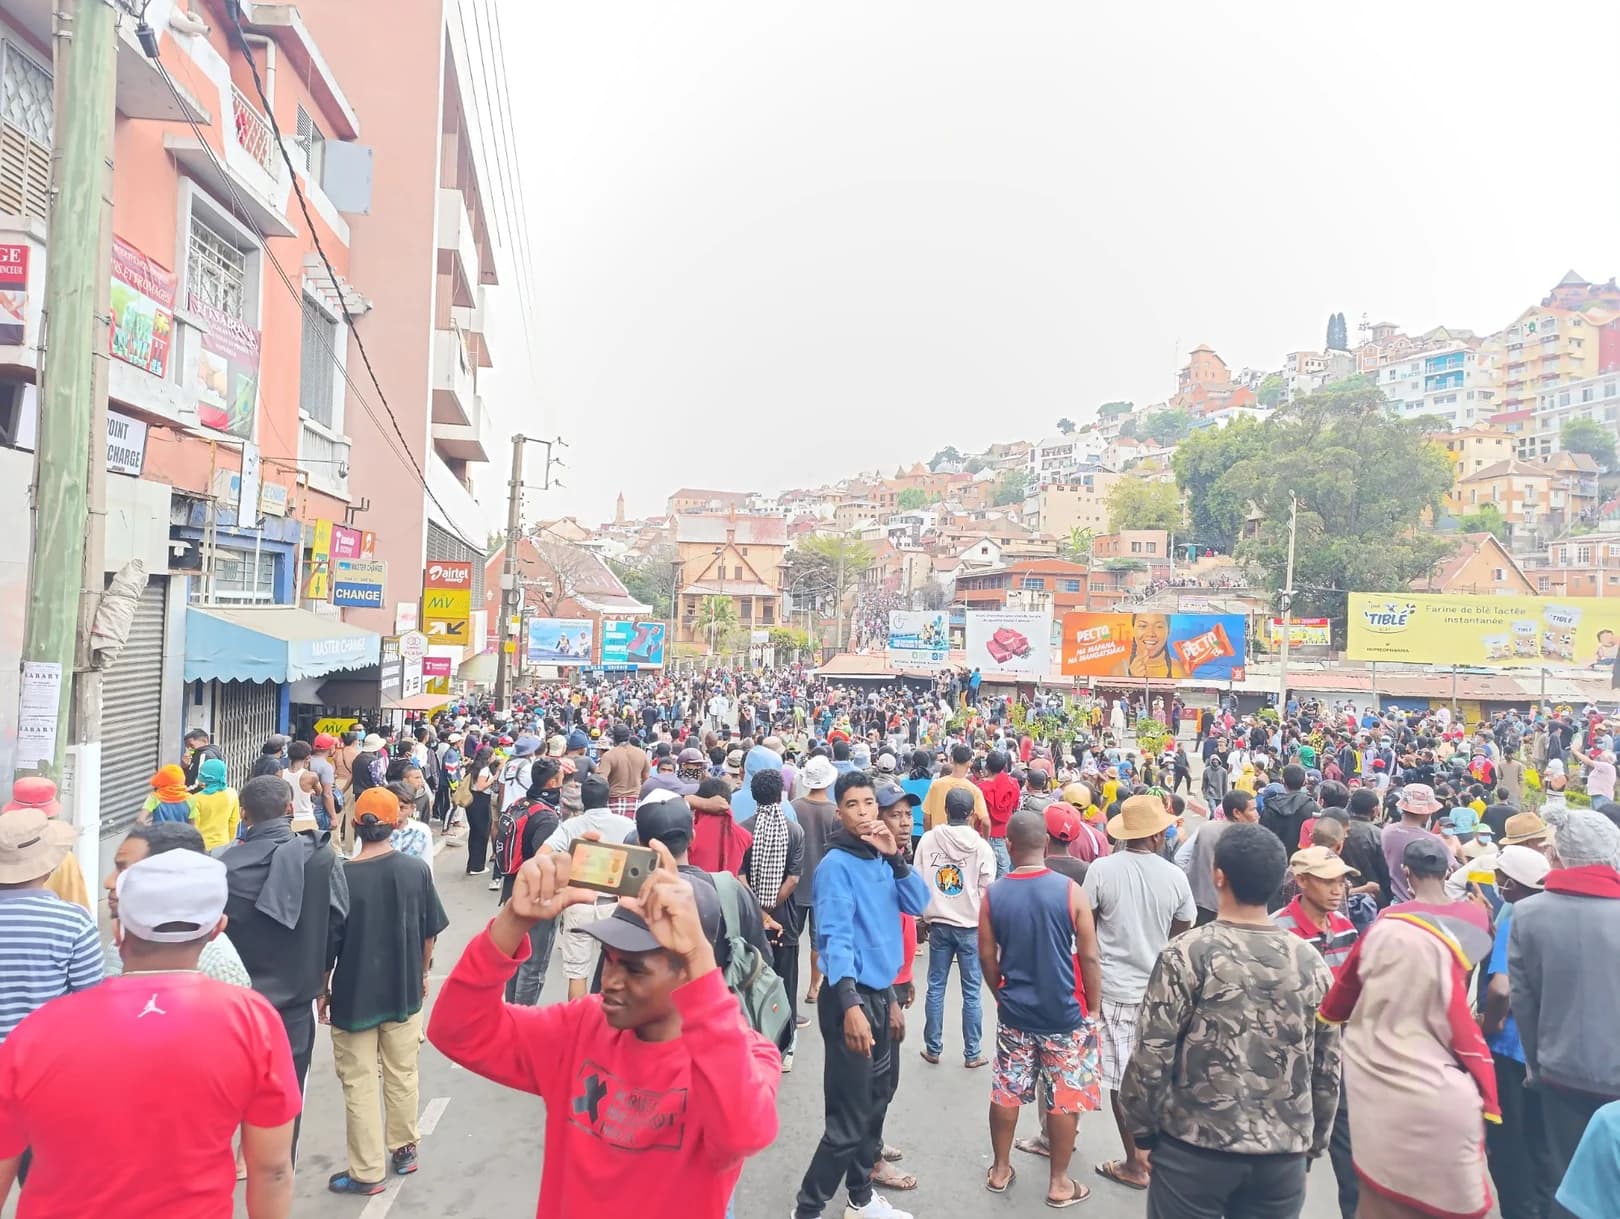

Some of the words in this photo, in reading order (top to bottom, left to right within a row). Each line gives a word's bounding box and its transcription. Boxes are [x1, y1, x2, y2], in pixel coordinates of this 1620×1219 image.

[107, 418, 129, 440] OINT
[442, 567, 469, 579] airtel
[335, 588, 380, 601] CHANGE
[1425, 604, 1457, 613] Farine
[1460, 606, 1472, 614] de
[1475, 606, 1491, 614] blé
[1494, 606, 1526, 615] lactée
[1444, 616, 1504, 625] instantanée
[1077, 625, 1110, 644] PECTO
[312, 640, 339, 656] MASTER
[1182, 631, 1219, 660] PECTO
